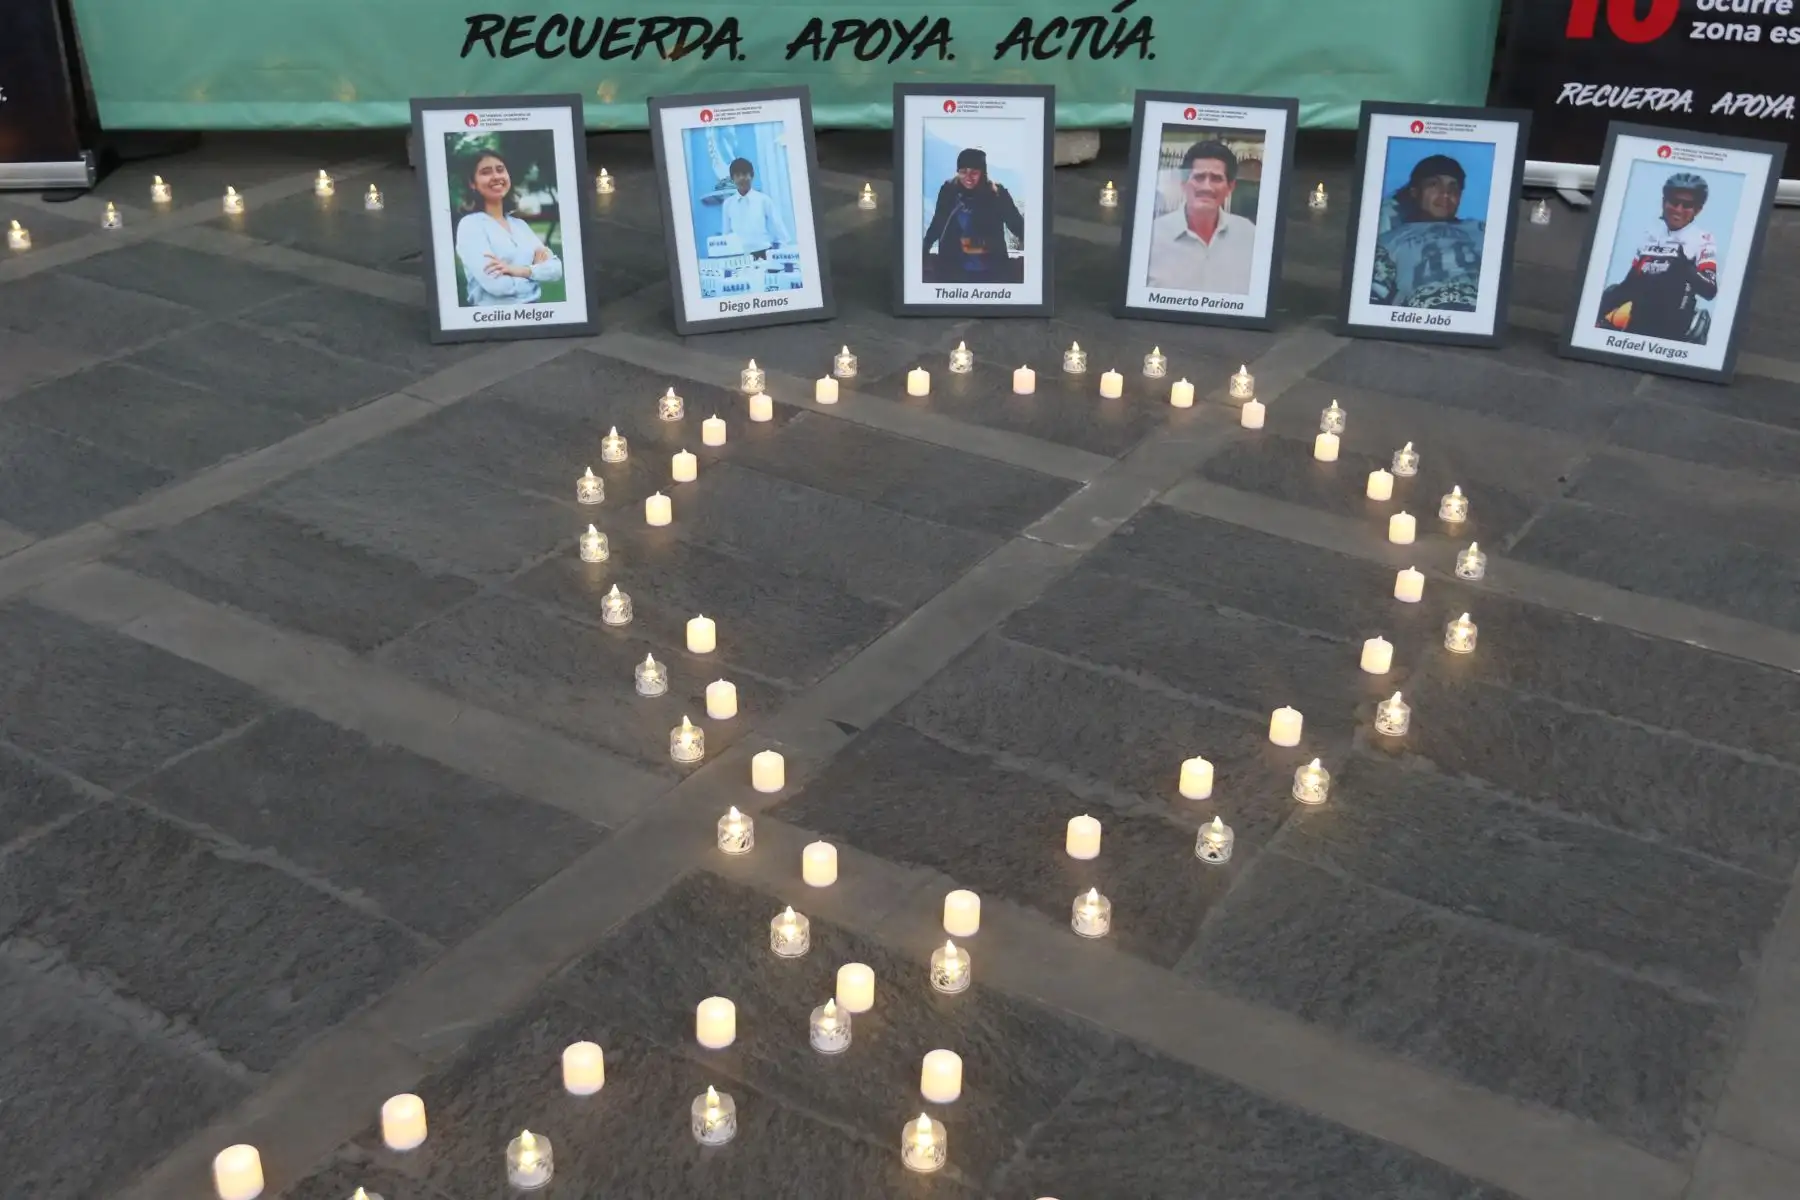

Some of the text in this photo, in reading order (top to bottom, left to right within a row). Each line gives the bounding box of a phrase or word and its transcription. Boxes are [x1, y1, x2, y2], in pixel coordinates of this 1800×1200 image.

[460, 0, 1156, 62] RECUERDA. APOYA. ACTÚA.
[1689, 21, 1761, 42] zona
[1555, 82, 1796, 120] RECUERDA. APOYA.
[935, 288, 1012, 299] Thalia Aranda
[1148, 292, 1244, 310] Mamerto Pariona
[719, 297, 789, 313] Diego Ramos
[473, 308, 555, 323] Cecilia Melgar
[1391, 311, 1452, 326] Eddie Jabó
[1605, 335, 1689, 360] Rafael Vargas
